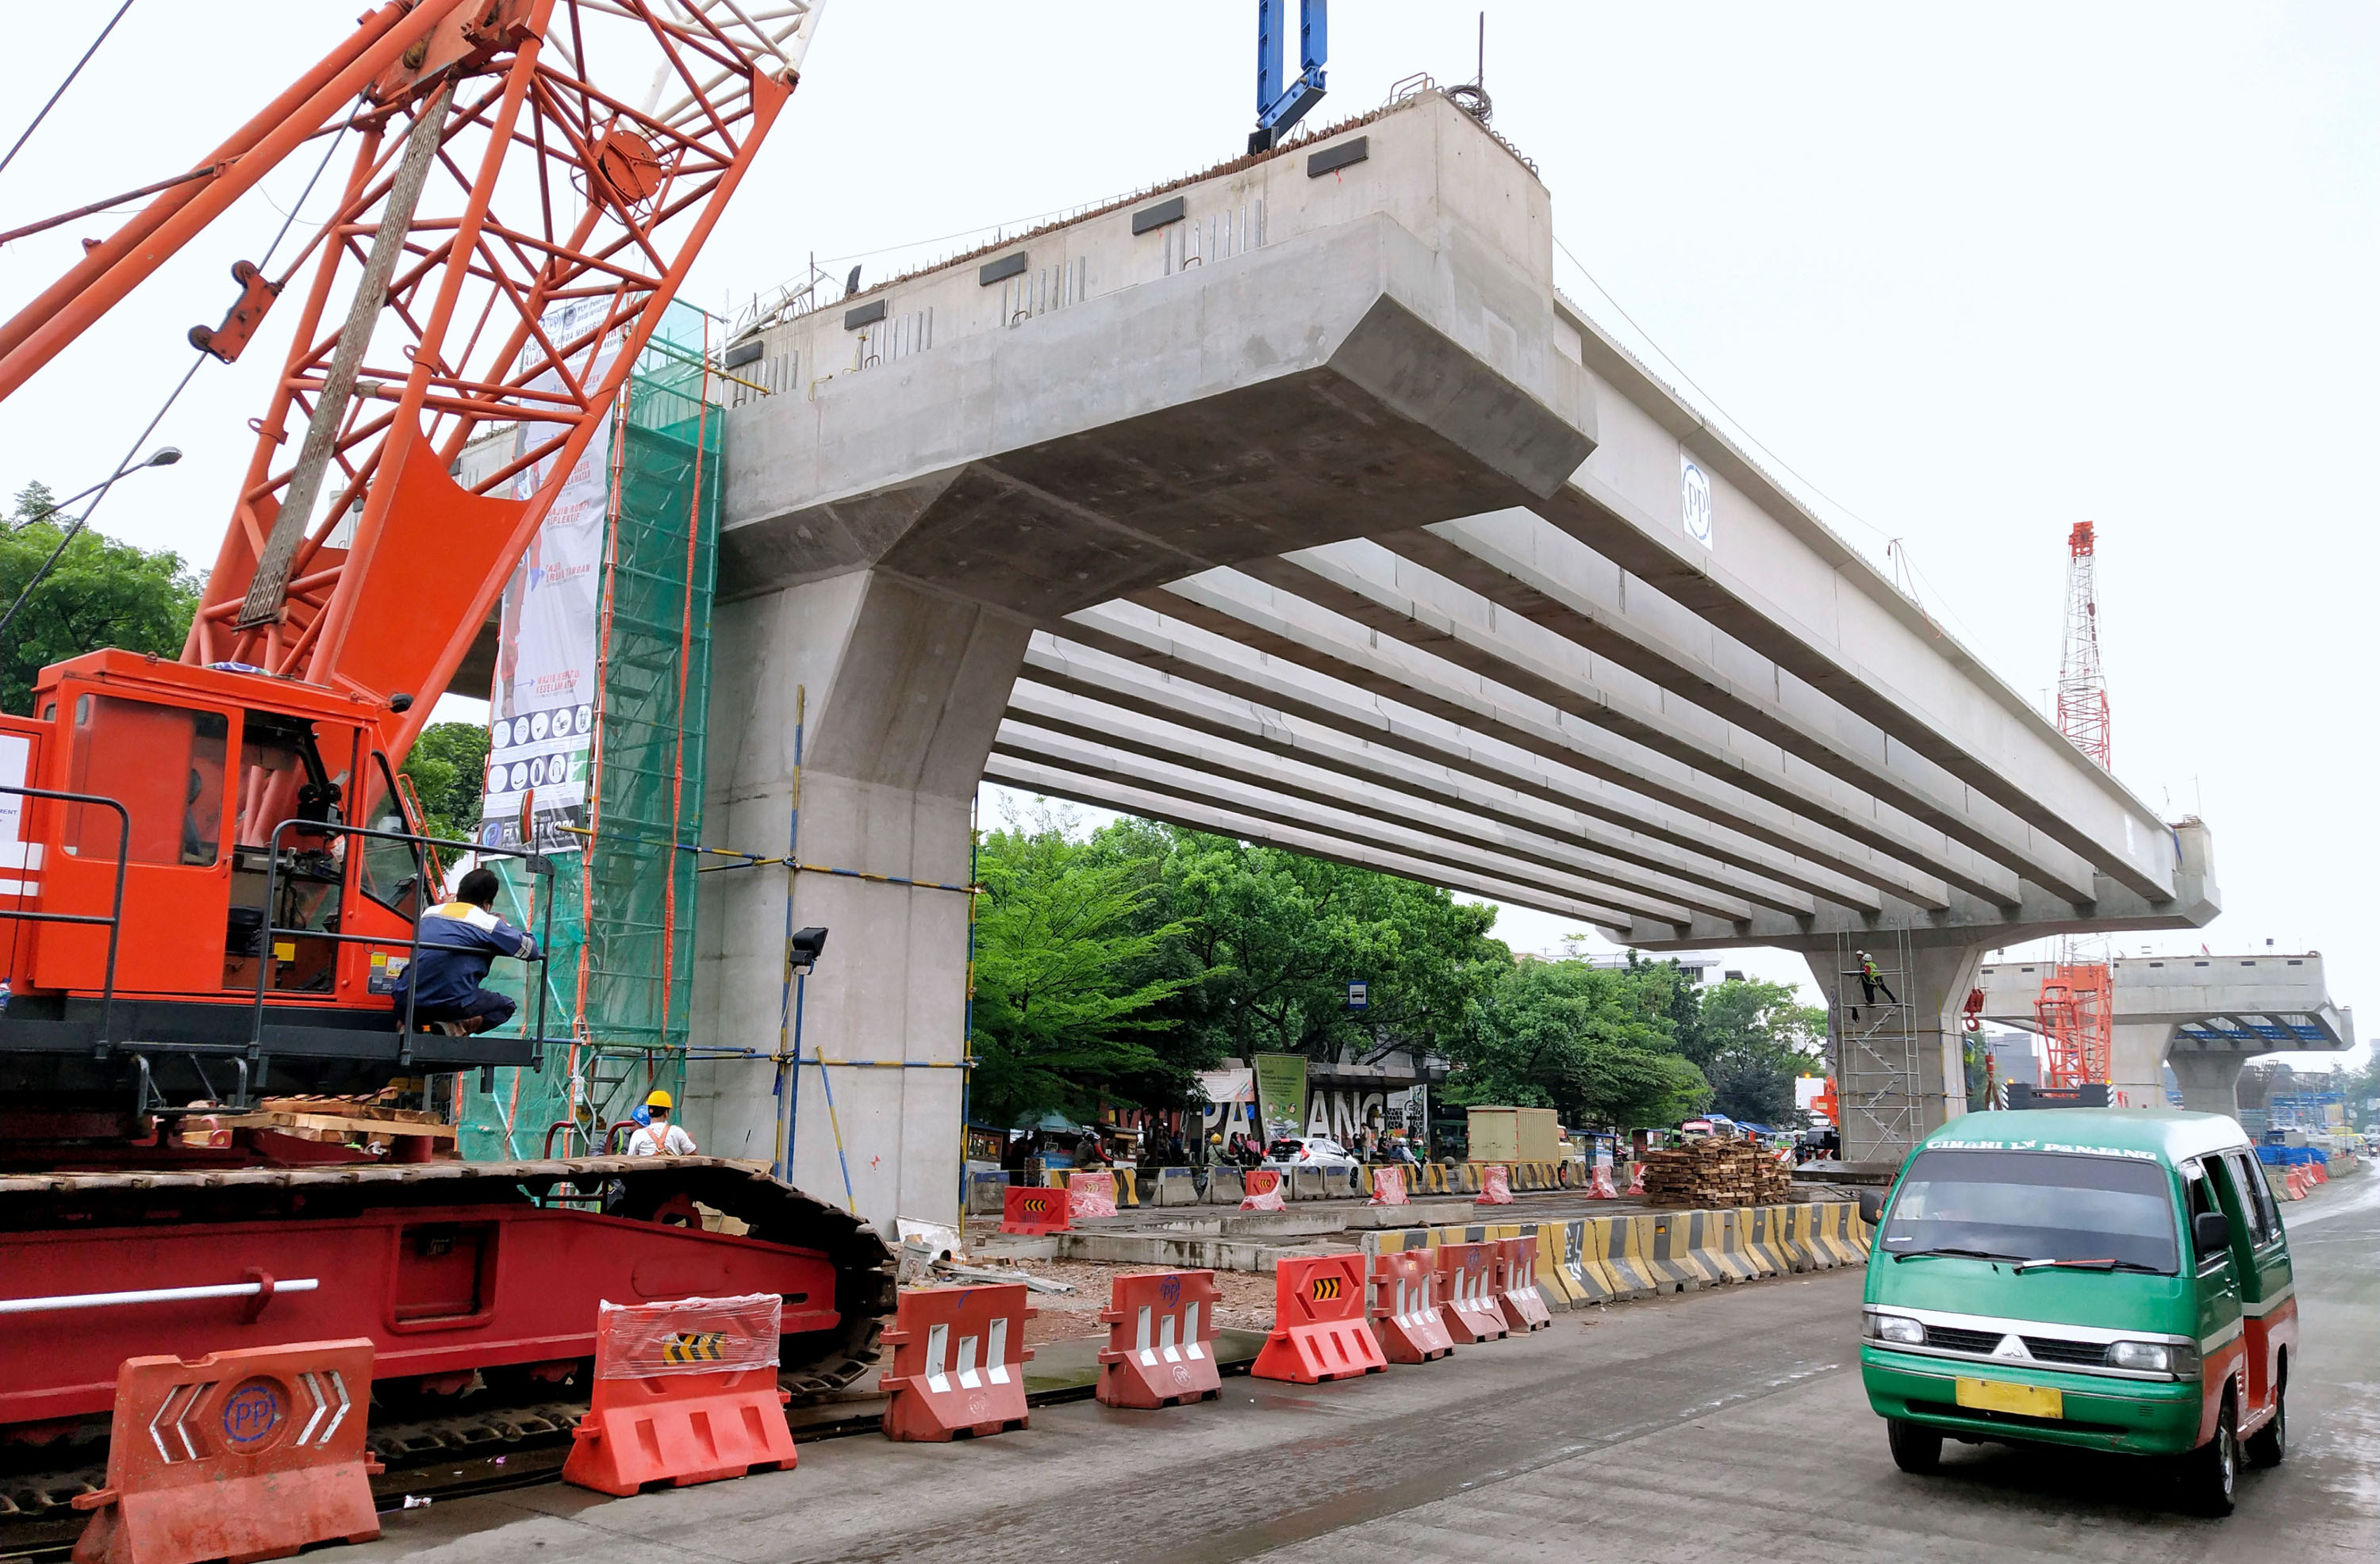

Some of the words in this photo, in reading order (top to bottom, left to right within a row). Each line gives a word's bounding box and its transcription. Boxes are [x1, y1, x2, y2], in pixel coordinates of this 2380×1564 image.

[1926, 1140, 2002, 1149] CIMAHI
[2044, 1143, 2157, 1160] PANJANG
[236, 1400, 269, 1429] PP
